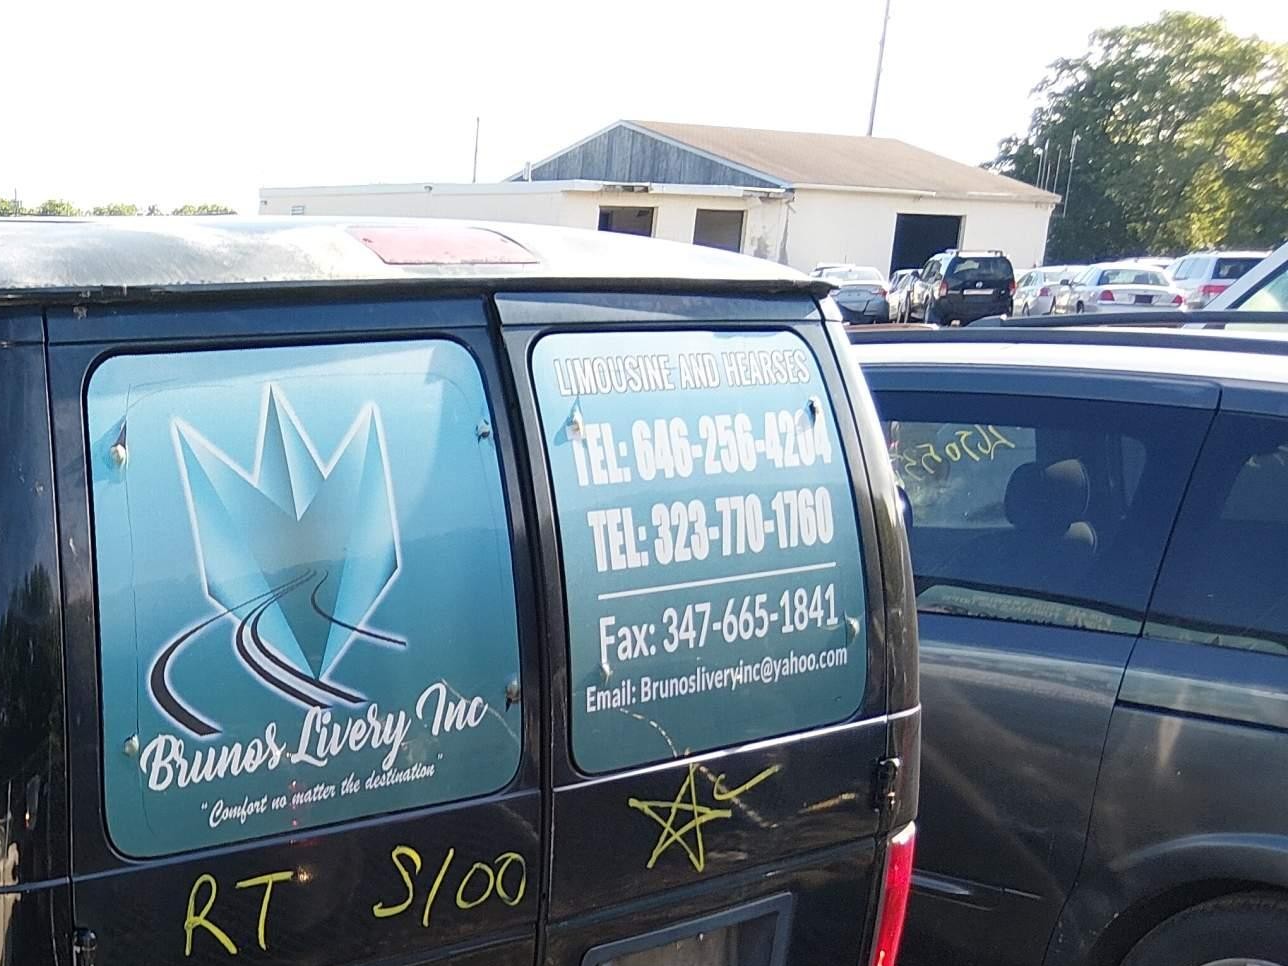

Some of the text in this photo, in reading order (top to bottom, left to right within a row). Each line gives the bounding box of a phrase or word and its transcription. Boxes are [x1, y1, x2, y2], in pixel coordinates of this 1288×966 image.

[553, 350, 811, 396] LIMOUSINE AND HEARSES
[571, 420, 632, 487] TEL:
[587, 485, 834, 572] TEL: 323-770-1760
[599, 583, 839, 664] Fax: 347-665-1841
[585, 646, 848, 713] Email: Brunosliveryinc@yahoo.com
[139, 682, 489, 792] Brunos Livery Inc
[271, 793, 288, 811] no
[291, 782, 337, 806] matter
[340, 771, 362, 795] the
[184, 873, 295, 957] RT
